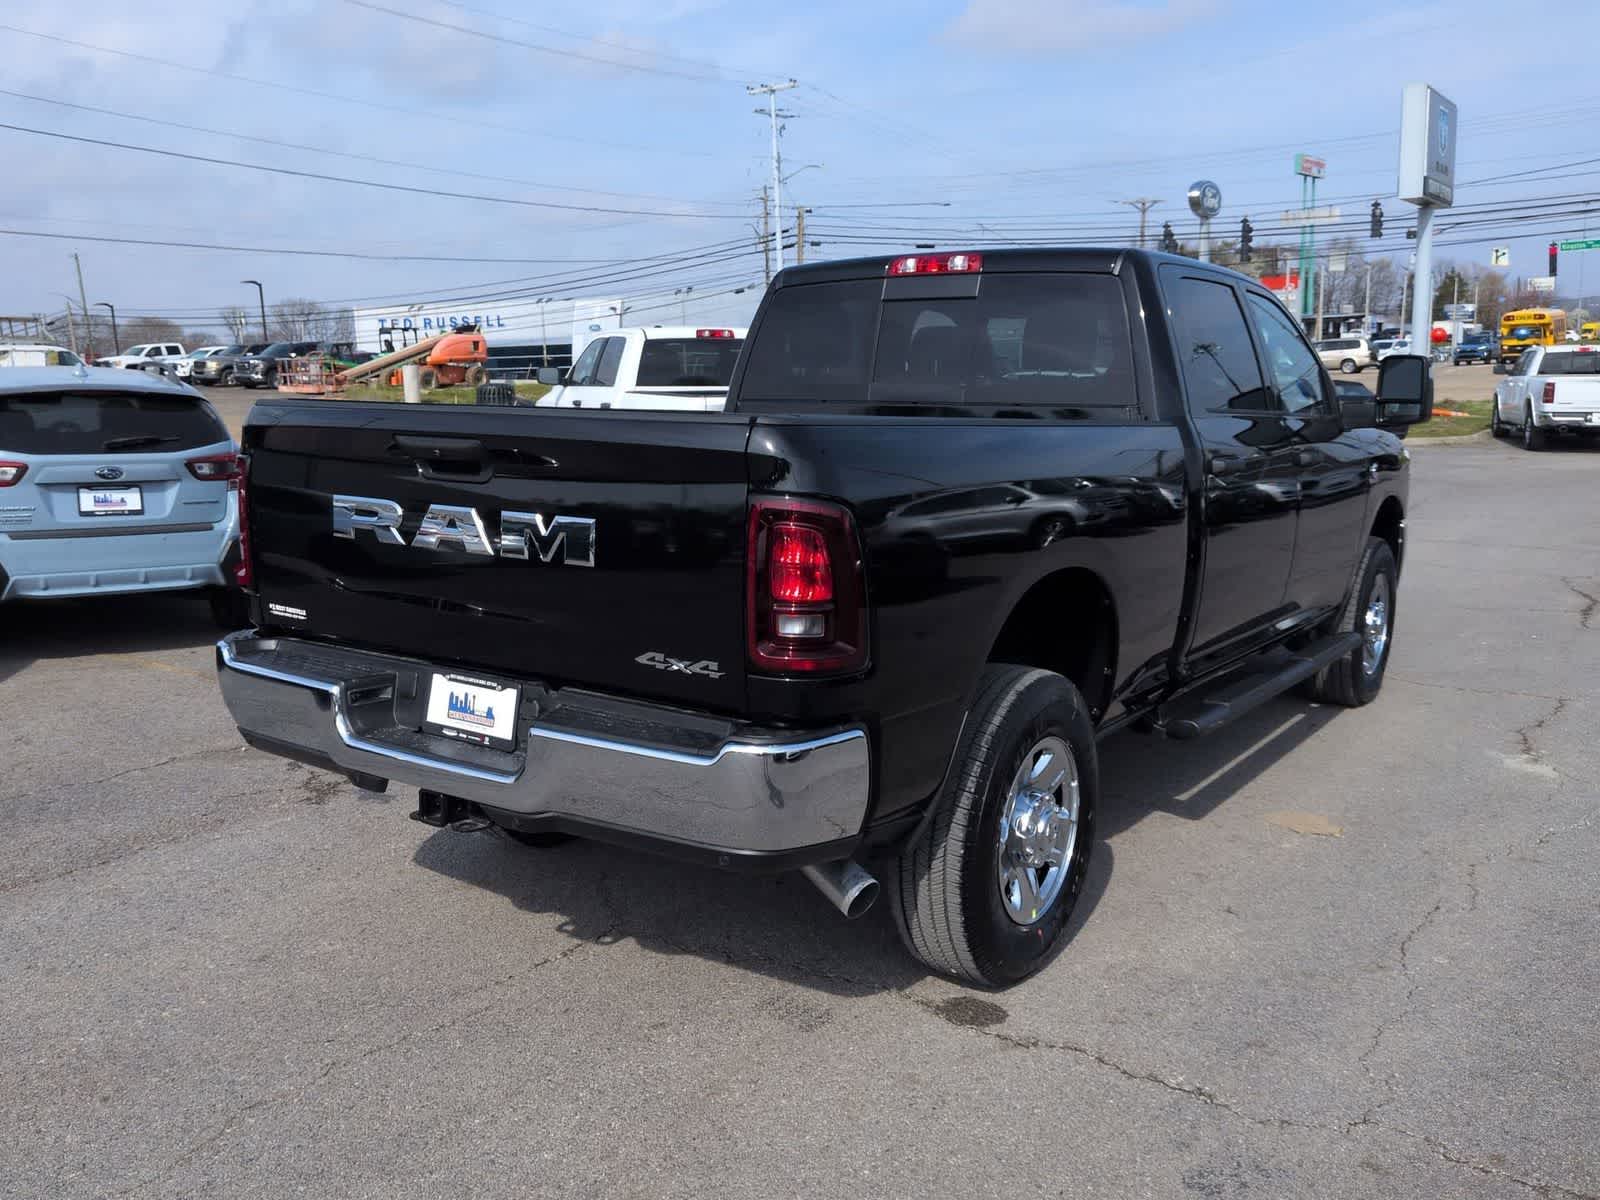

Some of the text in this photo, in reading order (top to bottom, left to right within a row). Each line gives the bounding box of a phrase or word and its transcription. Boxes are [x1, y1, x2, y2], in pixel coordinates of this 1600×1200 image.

[379, 315, 505, 330] TED RUSSELL
[333, 494, 596, 568] RAM
